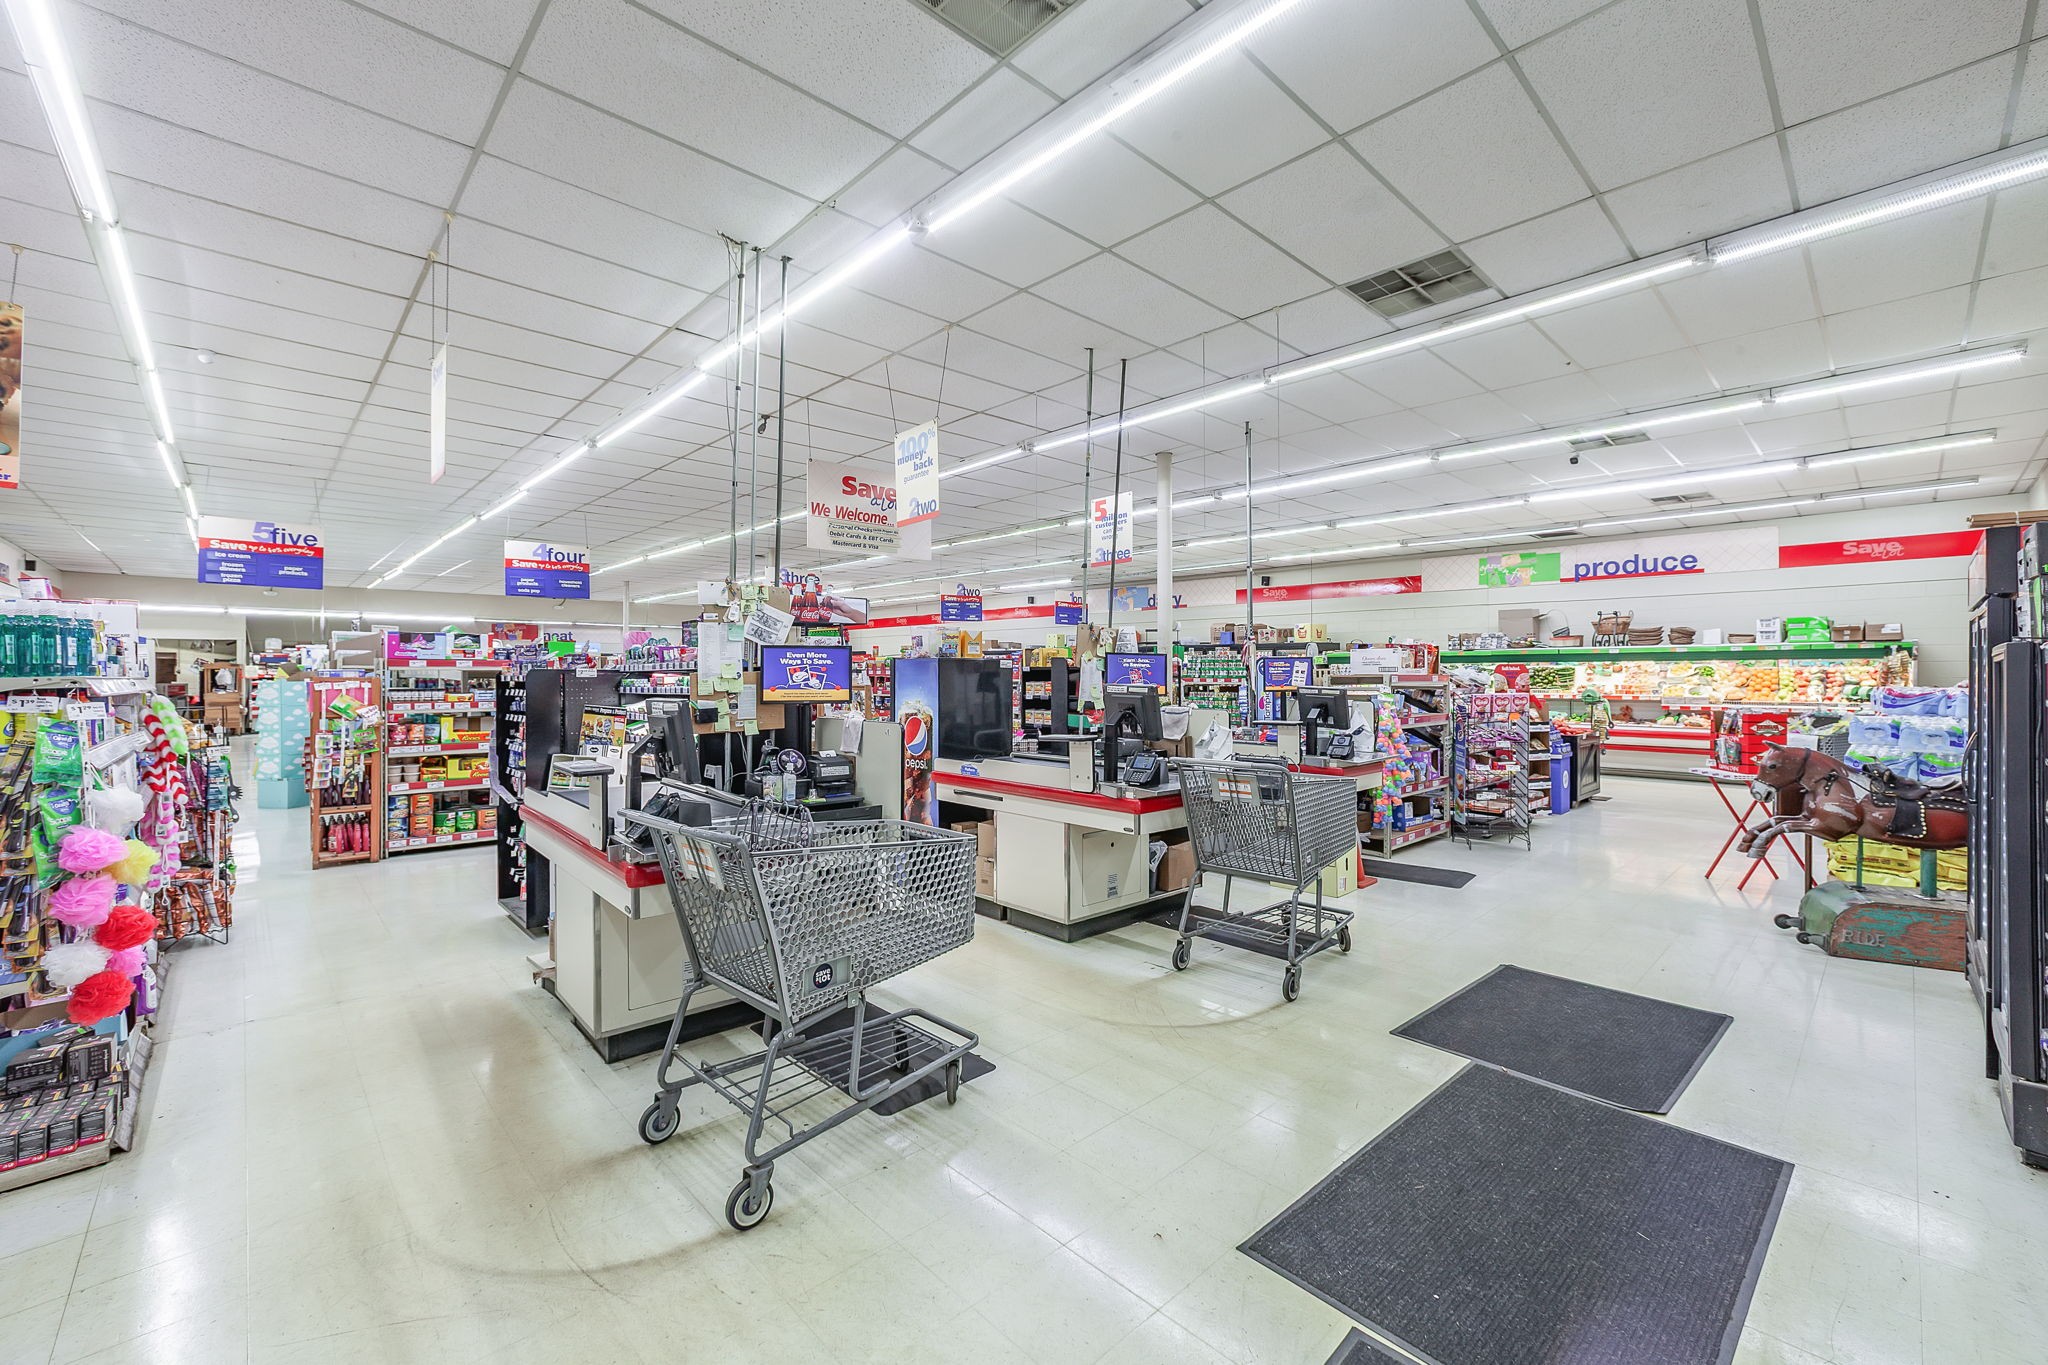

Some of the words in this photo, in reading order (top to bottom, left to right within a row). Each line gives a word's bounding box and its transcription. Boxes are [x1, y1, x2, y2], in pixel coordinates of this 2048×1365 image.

[913, 456, 933, 471] back
[904, 469, 929, 484] guarantee
[842, 476, 896, 502] Save
[811, 502, 830, 517] We
[1095, 499, 1107, 521] 5
[1096, 518, 1127, 529] custoers
[1102, 512, 1127, 522] milon
[846, 533, 861, 541] Cards
[210, 540, 247, 550] Save
[832, 540, 861, 548] Mastercard
[1843, 542, 1900, 556] Save
[512, 560, 538, 568] Save
[1574, 554, 1698, 583] produce
[780, 658, 801, 666] Ways
[905, 758, 928, 771] pepsi
